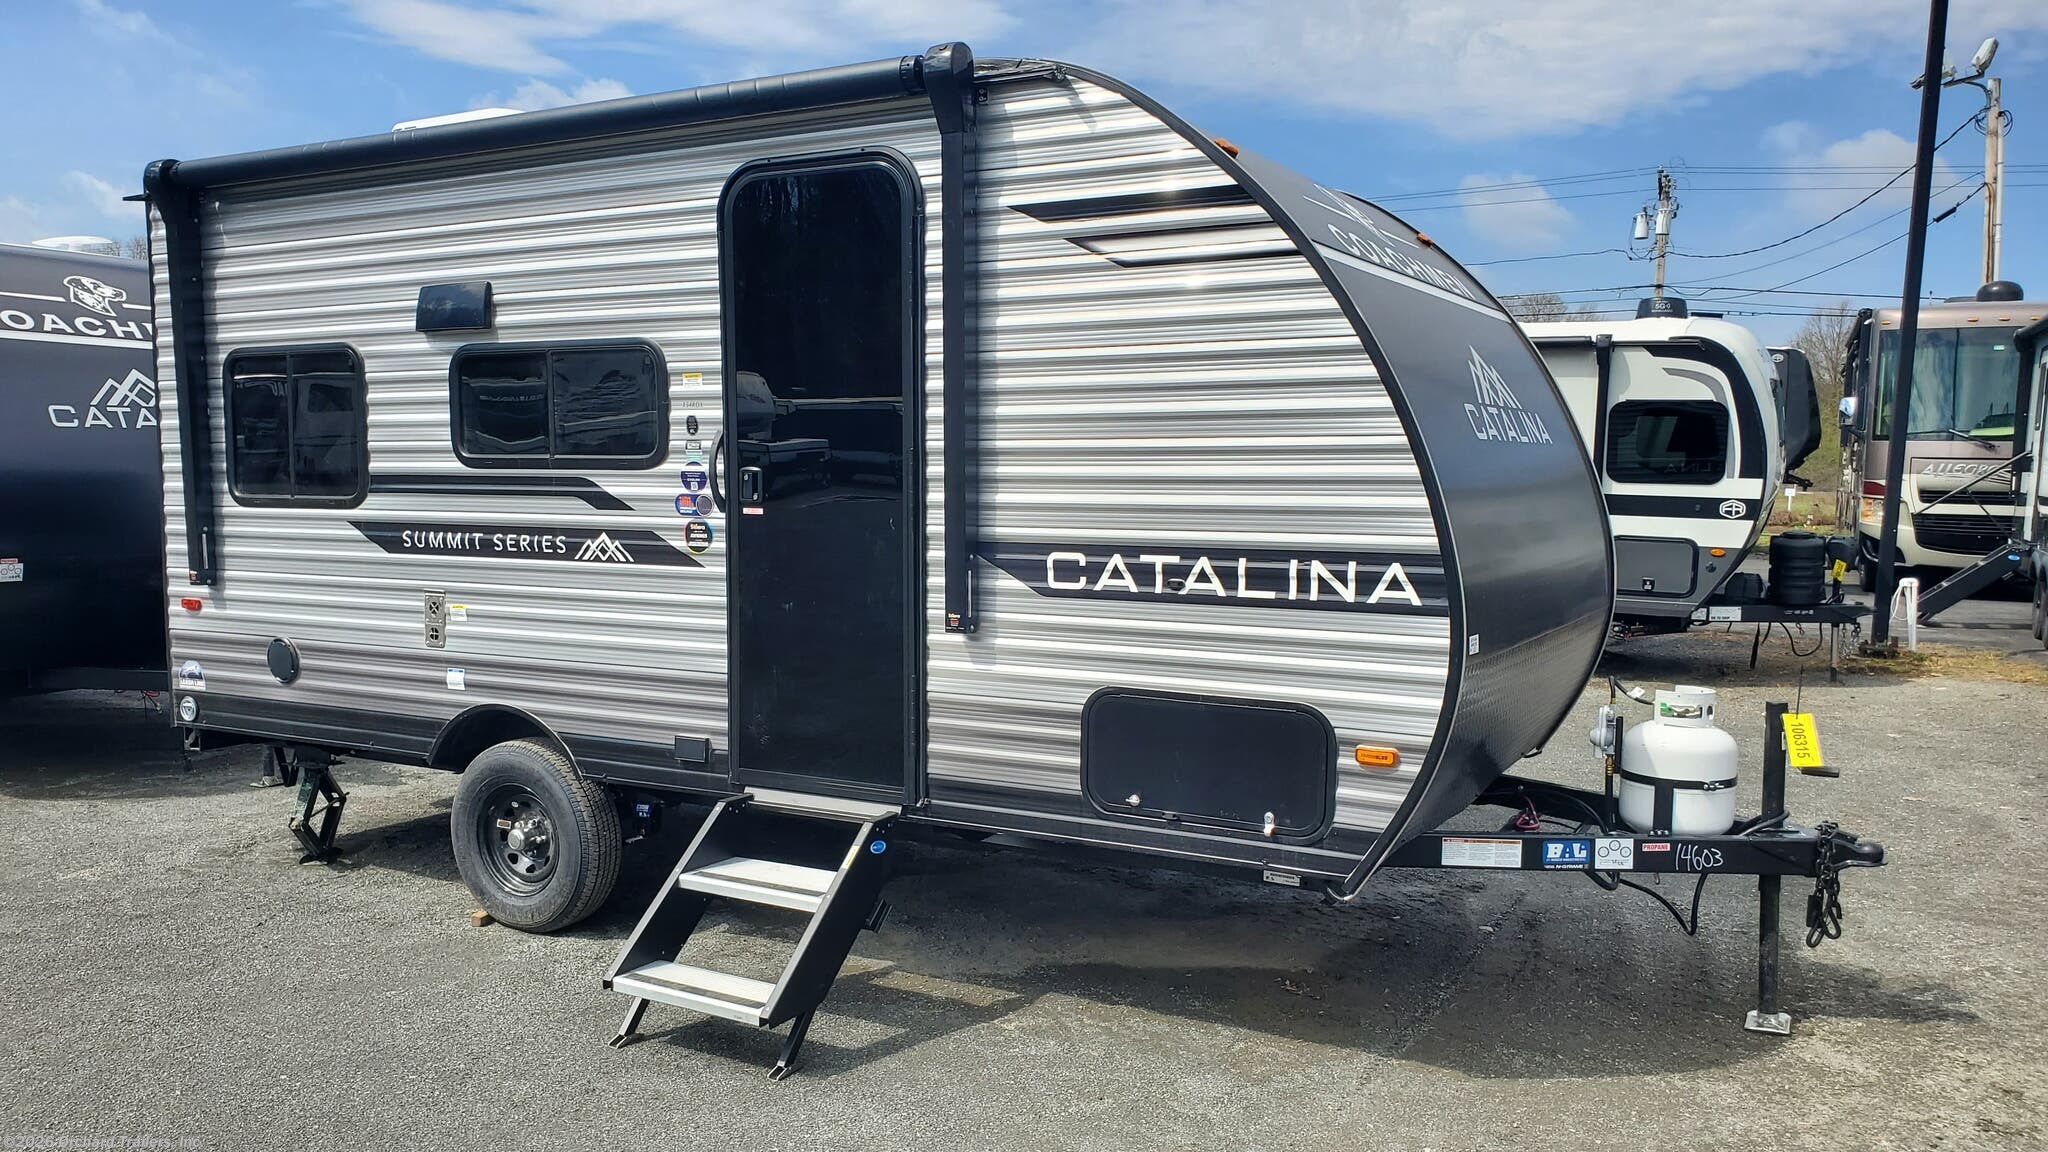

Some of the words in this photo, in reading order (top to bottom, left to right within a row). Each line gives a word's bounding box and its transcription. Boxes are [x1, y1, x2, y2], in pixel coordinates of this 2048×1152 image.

[1464, 403, 1553, 444] CATALINA
[402, 530, 483, 549] SUMMIT
[493, 534, 567, 554] SERIES
[1046, 552, 1422, 606] CATALINA
[1791, 723, 1811, 758] 106315
[1675, 843, 1724, 871] 14603
